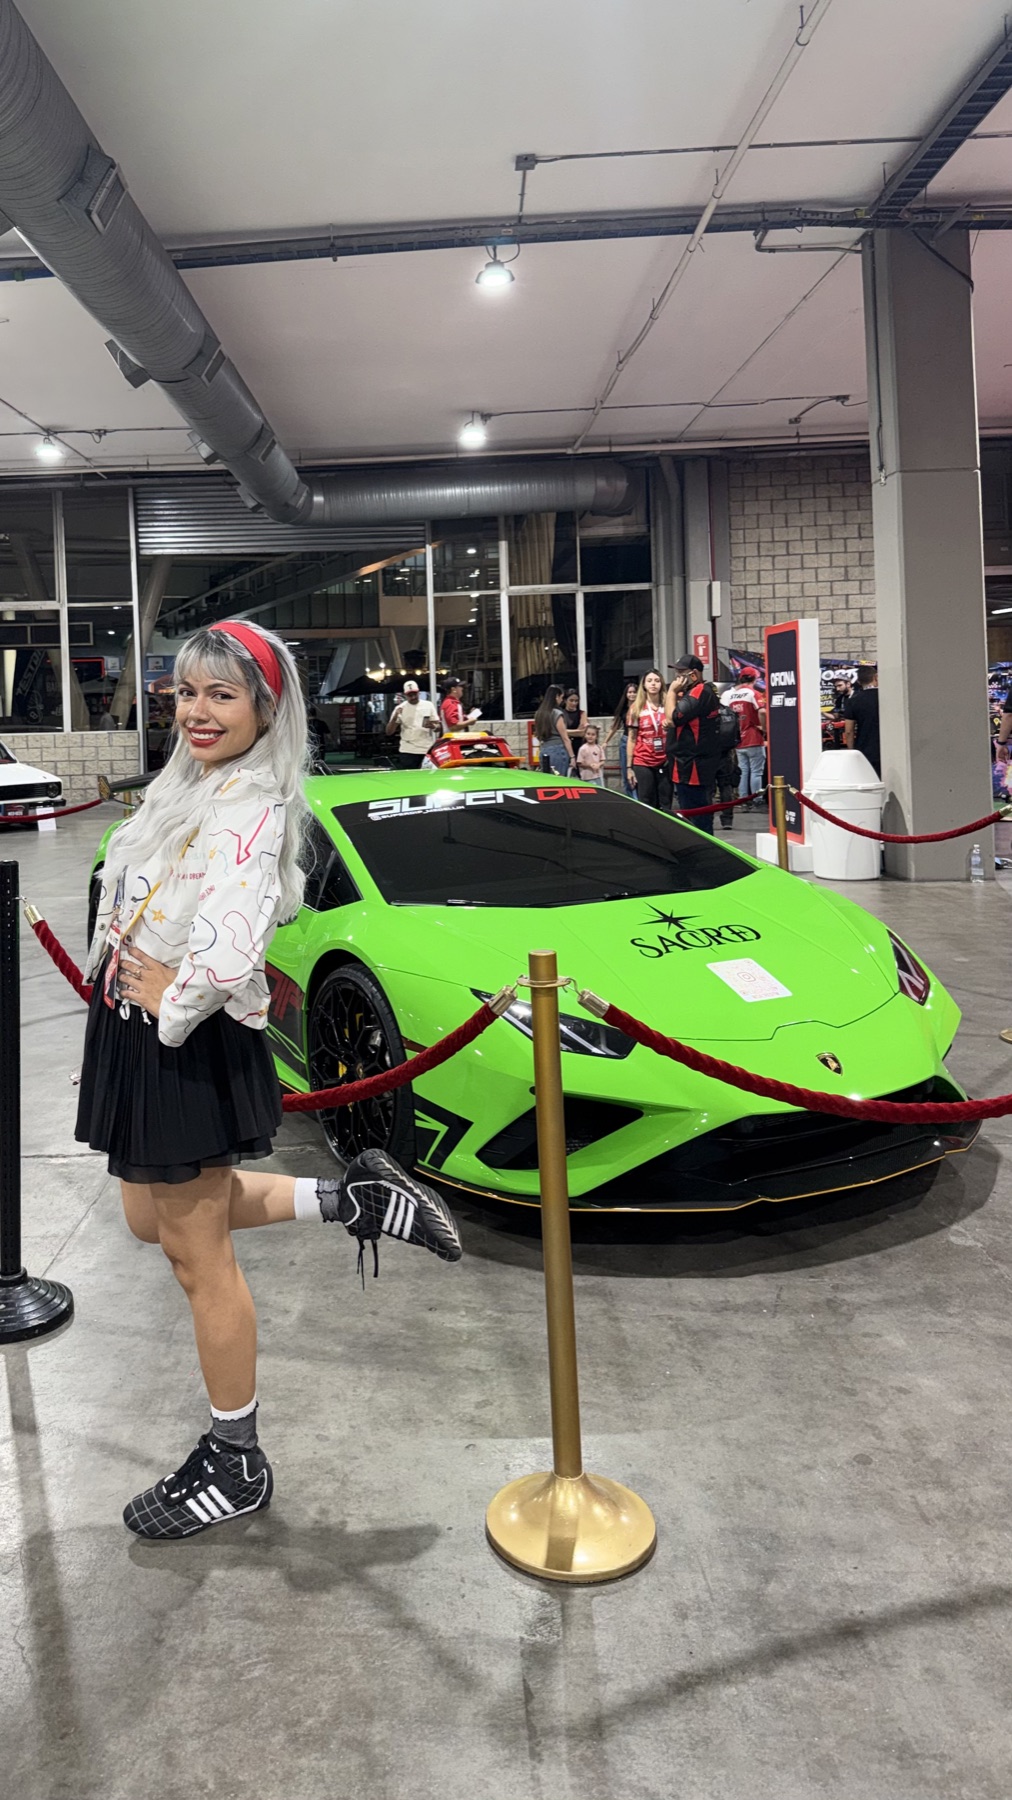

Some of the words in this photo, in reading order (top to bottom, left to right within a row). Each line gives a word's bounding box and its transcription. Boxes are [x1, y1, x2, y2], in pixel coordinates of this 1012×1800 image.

[770, 671, 796, 687] OFICINA
[730, 692, 749, 700] STAFF
[368, 788, 540, 817] SUPER
